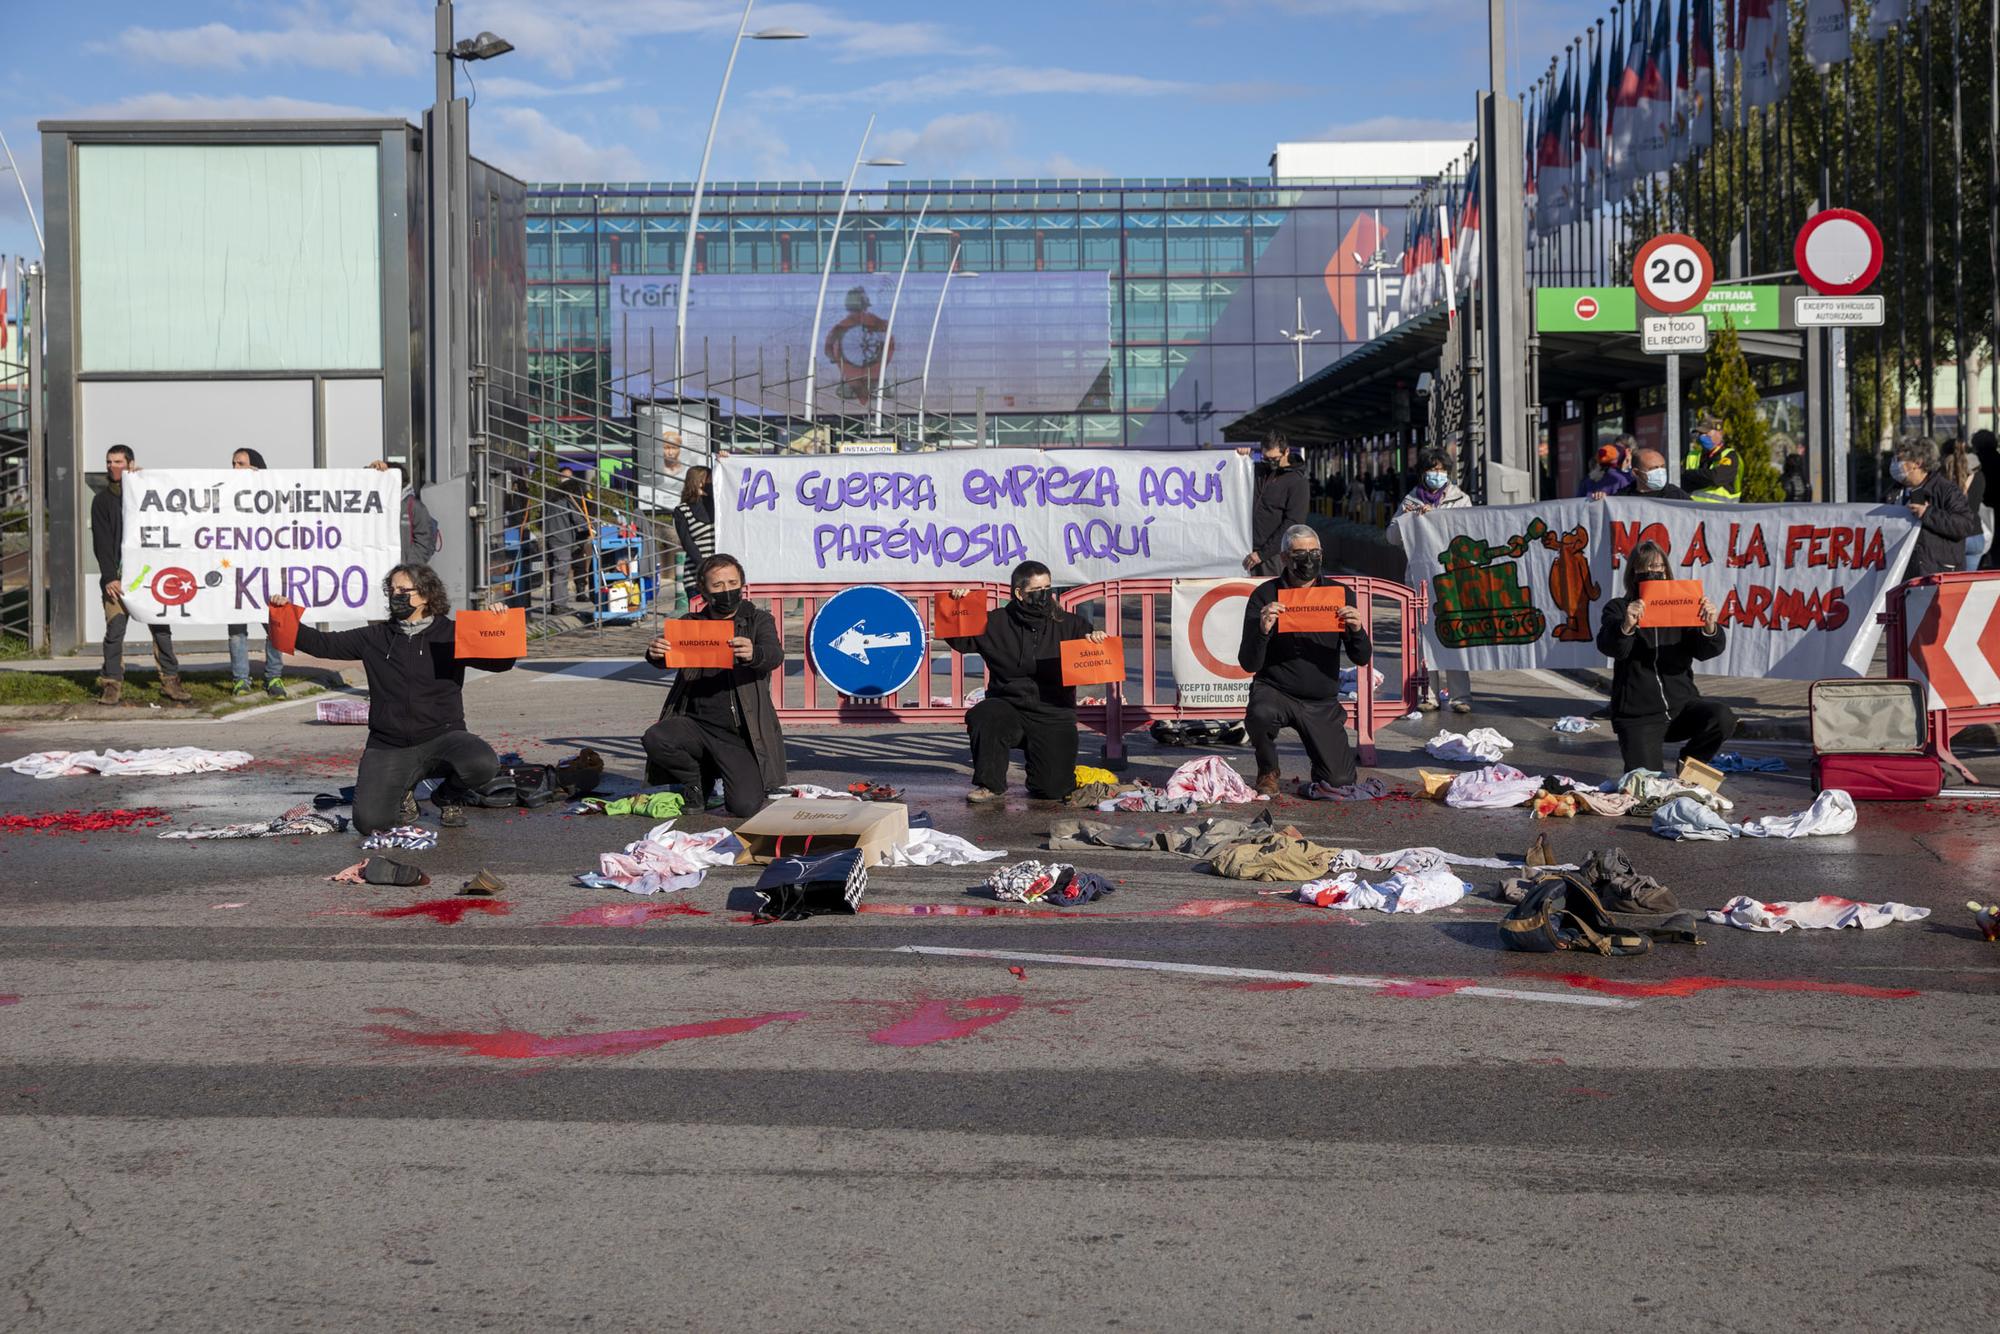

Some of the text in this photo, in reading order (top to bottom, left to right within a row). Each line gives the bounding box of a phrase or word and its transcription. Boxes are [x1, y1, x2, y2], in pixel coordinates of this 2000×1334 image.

[1650, 258, 1695, 284] 20
[1367, 277, 1401, 307] IF
[1703, 302, 1758, 313] ENTRANCE
[1803, 302, 1834, 311] EXCEPTO
[1816, 312, 1863, 320] AUTORIZADOS
[1653, 321, 1696, 333] EN TODO
[1647, 335, 1703, 346] EL RECINTO
[843, 444, 892, 453] INSTALACIÓN
[139, 482, 225, 516] AQUÍ
[140, 526, 182, 549] EL
[1610, 521, 1887, 571] NO A LA FERIA
[234, 565, 369, 610] KURDO
[1650, 598, 1694, 606] AFGANISTÁN
[1716, 584, 1850, 632] ARMAS
[679, 639, 720, 647] KURDISTÁN
[1073, 658, 1113, 669] OCCIDENTAL
[1212, 682, 1250, 692] TRANSPO
[1183, 692, 1250, 703] Y VEHÍCULOS AU
